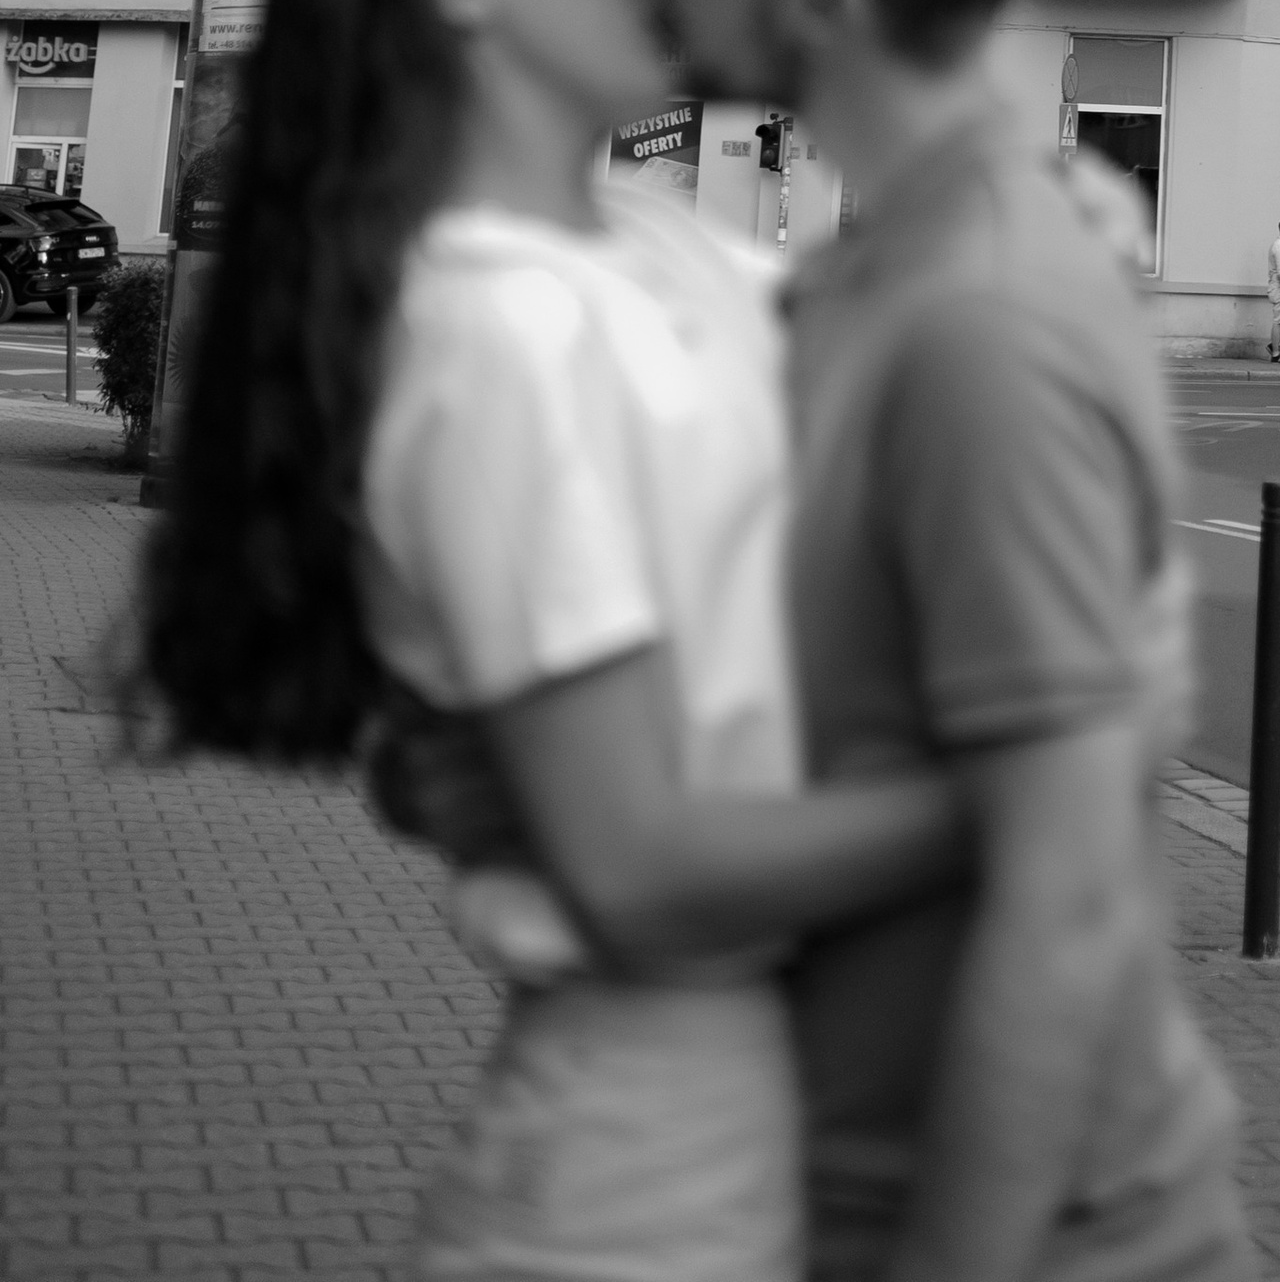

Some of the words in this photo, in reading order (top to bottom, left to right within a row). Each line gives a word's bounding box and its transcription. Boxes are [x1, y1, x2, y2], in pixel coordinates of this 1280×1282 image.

[7, 35, 88, 62] żabka
[618, 106, 693, 141] WSZYSTKIE
[632, 132, 683, 159] OFERTY
